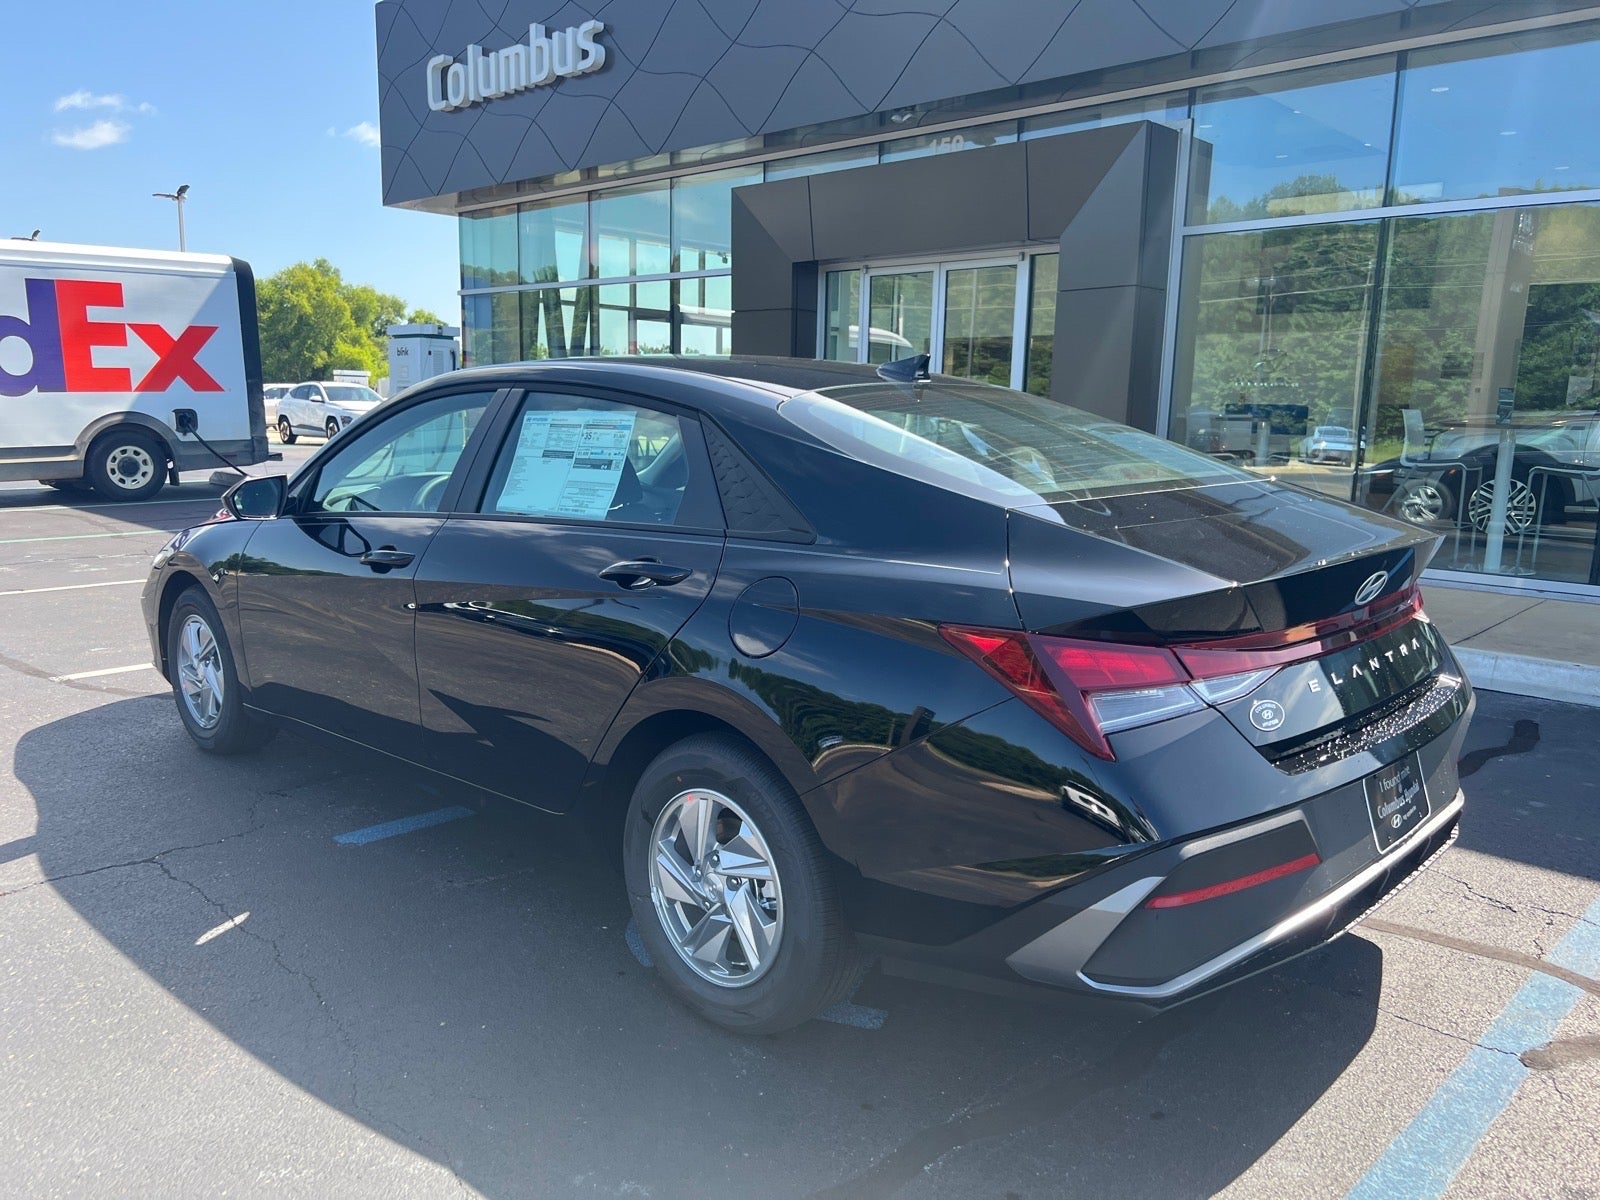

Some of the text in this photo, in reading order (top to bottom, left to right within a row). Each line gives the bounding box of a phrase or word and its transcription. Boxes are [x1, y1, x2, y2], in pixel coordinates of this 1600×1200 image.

[426, 19, 606, 112] Columbus
[396, 346, 409, 357] blink
[1308, 637, 1420, 693] ELANTRA
[1382, 771, 1401, 791] found
[1377, 794, 1406, 820] Columbus
